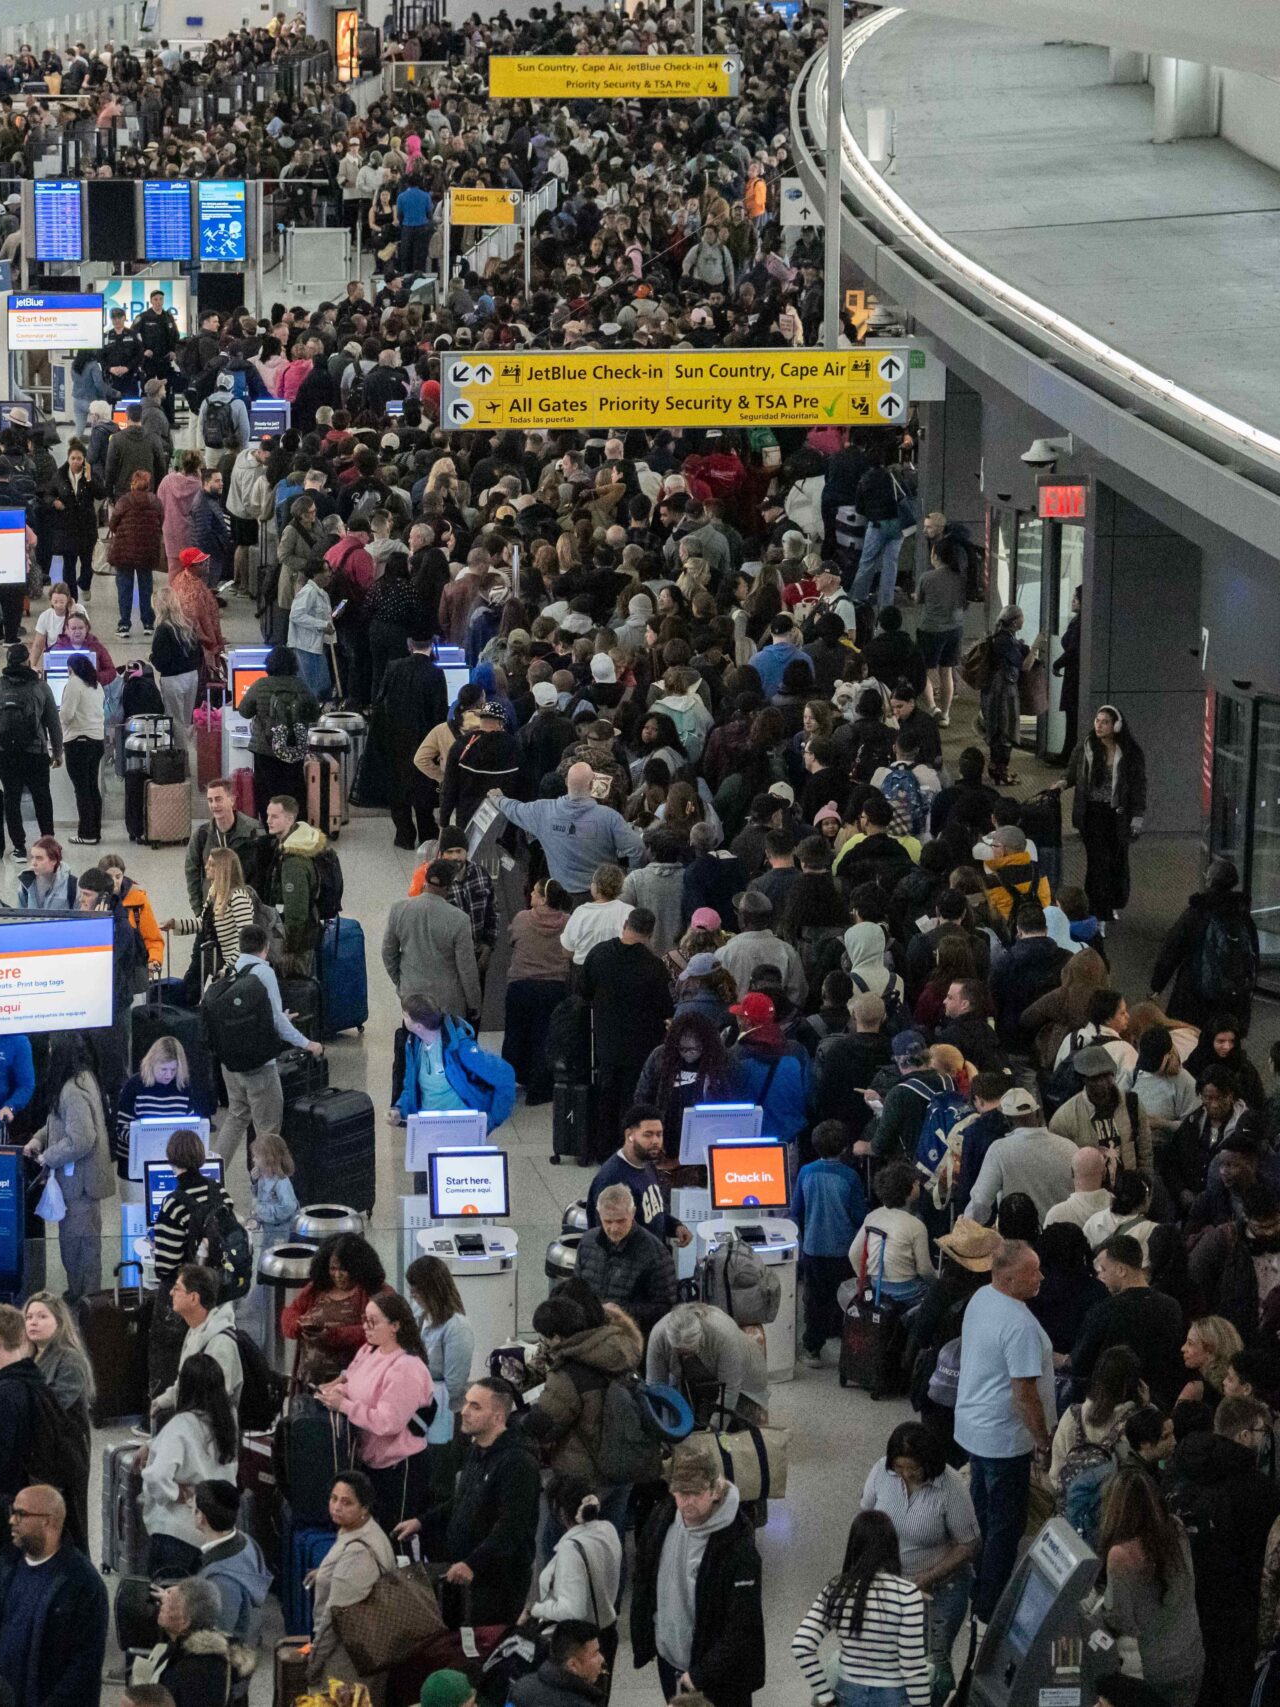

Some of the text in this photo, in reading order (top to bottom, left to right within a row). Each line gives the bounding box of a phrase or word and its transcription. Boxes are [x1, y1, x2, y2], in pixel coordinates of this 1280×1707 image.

[517, 63, 535, 72] Sun
[538, 63, 579, 73] Country,
[582, 63, 606, 74] Cape
[626, 62, 661, 72] JetBlue
[664, 61, 704, 72] Check-in
[566, 79, 691, 91] Priority Security & TSA Pre
[454, 193, 489, 202] All Gates
[16, 297, 44, 308] jetBlue
[16, 315, 58, 323] Start here
[526, 364, 663, 381] JetBlue Check-in
[675, 362, 847, 381] Sun Country, Cape Air
[508, 398, 588, 412] All Gates
[599, 394, 819, 415] Priority Security & TSA Pre
[509, 415, 575, 425] Todas las puertas
[739, 411, 819, 422] Seguridad Prioritaria
[1046, 486, 1083, 515] EXIT
[35, 980, 47, 988] bag
[49, 979, 64, 987] tags
[446, 1175, 492, 1186] Start here.
[724, 1171, 774, 1184] Check in.
